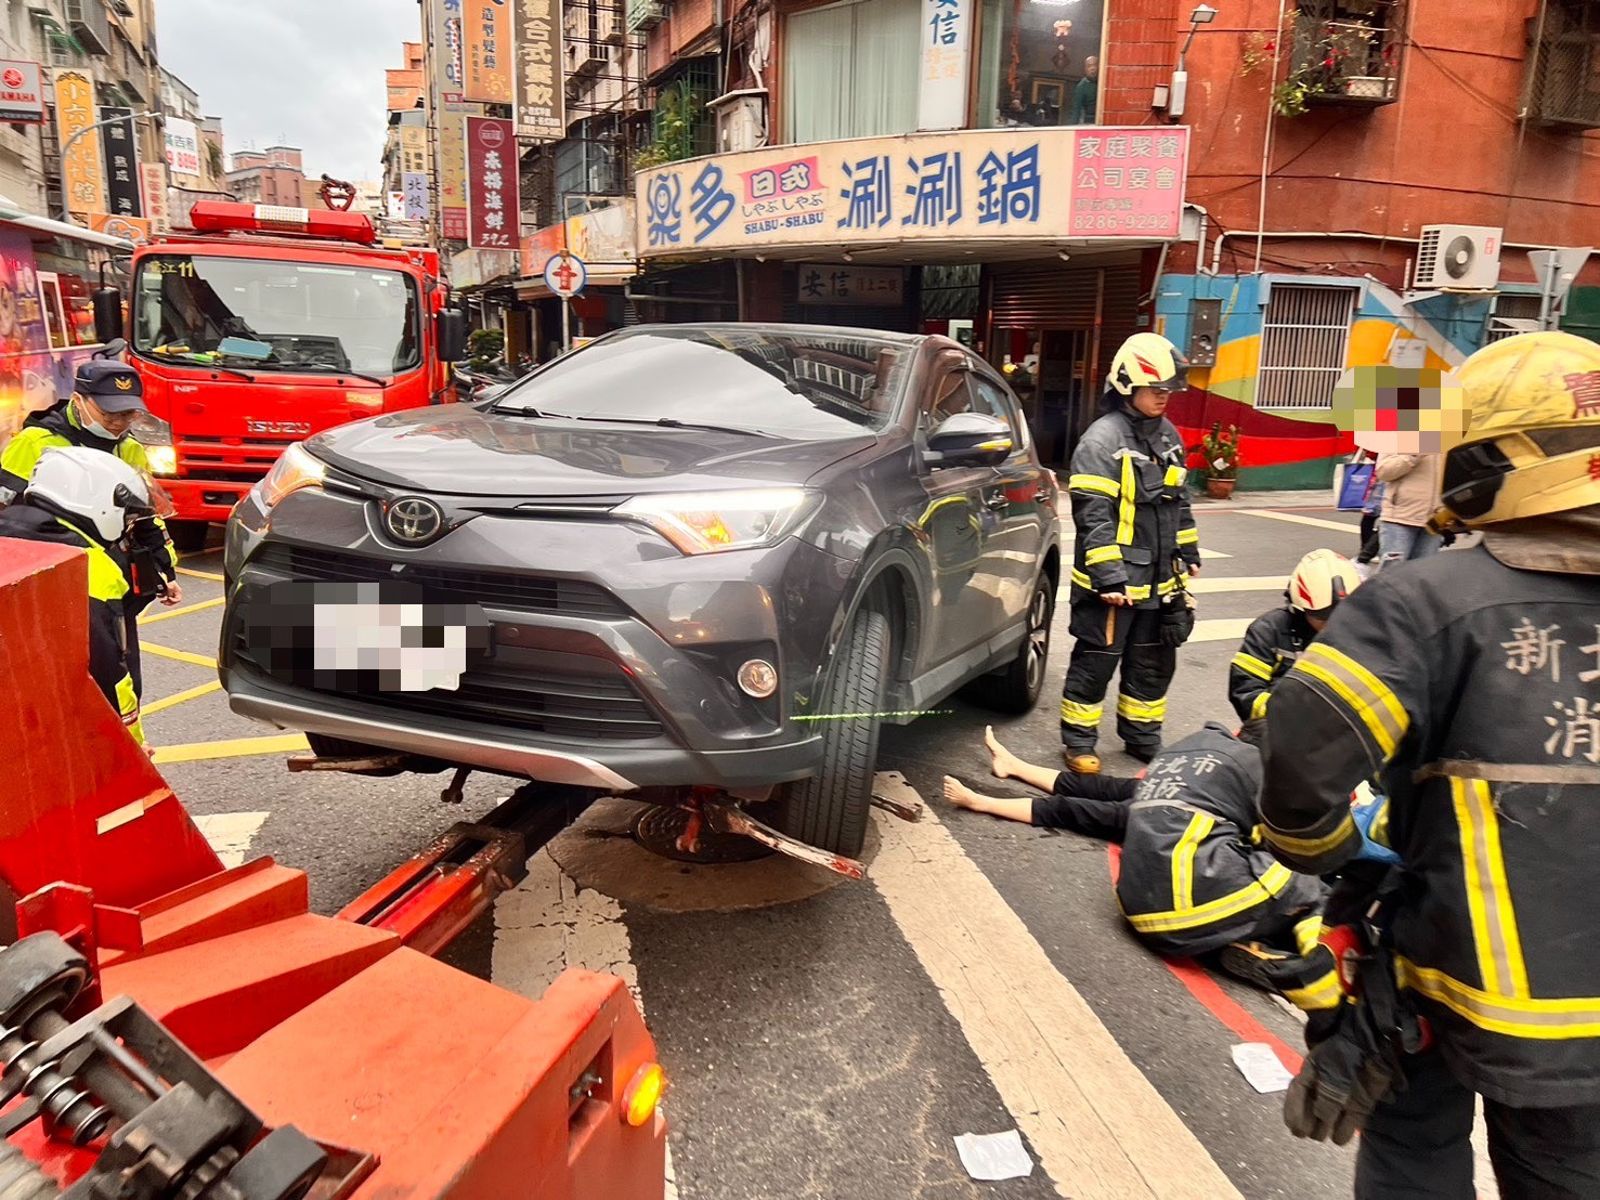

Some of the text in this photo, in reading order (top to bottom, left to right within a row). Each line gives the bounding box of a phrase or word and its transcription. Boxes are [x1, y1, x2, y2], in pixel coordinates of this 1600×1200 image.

[1079, 136, 1179, 159] 家庭聚餐
[752, 162, 810, 198] 日式
[1077, 166, 1177, 190] 公司宴會
[837, 143, 1041, 237] 涮涮鍋
[1073, 214, 1169, 230] 8286-9292
[178, 261, 193, 277] 11
[801, 269, 851, 297] 安信
[247, 421, 311, 434] ISUZU
